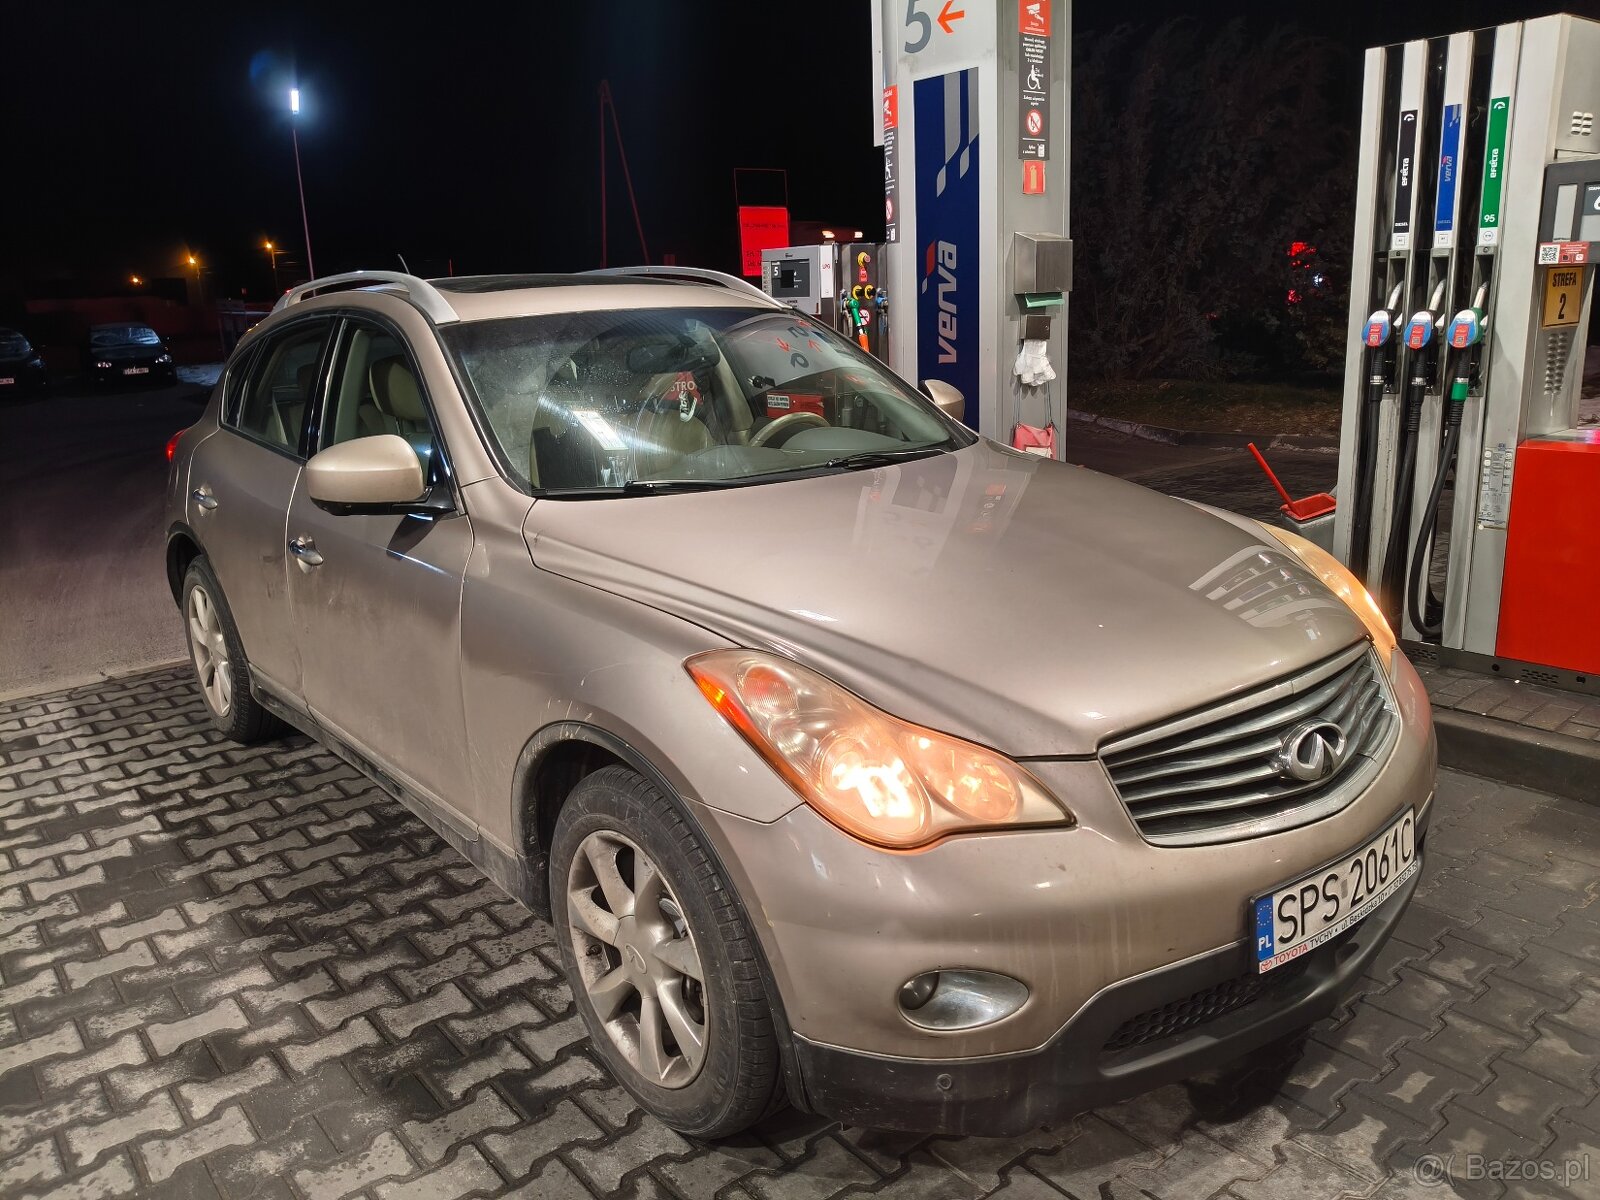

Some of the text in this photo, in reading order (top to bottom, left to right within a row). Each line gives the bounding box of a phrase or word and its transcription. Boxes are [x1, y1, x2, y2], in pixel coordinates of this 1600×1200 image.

[904, 0, 932, 54] 5
[1444, 156, 1453, 182] verva
[1483, 213, 1496, 223] 95
[773, 266, 779, 277] 5
[1552, 272, 1577, 287] STREFA
[938, 240, 957, 364] verva
[1557, 292, 1567, 320] 2
[1277, 818, 1411, 944] SPS 2061C
[1258, 935, 1272, 951] PL
[1274, 944, 1309, 965] TOYOTA
[1309, 928, 1333, 948] TYCHY
